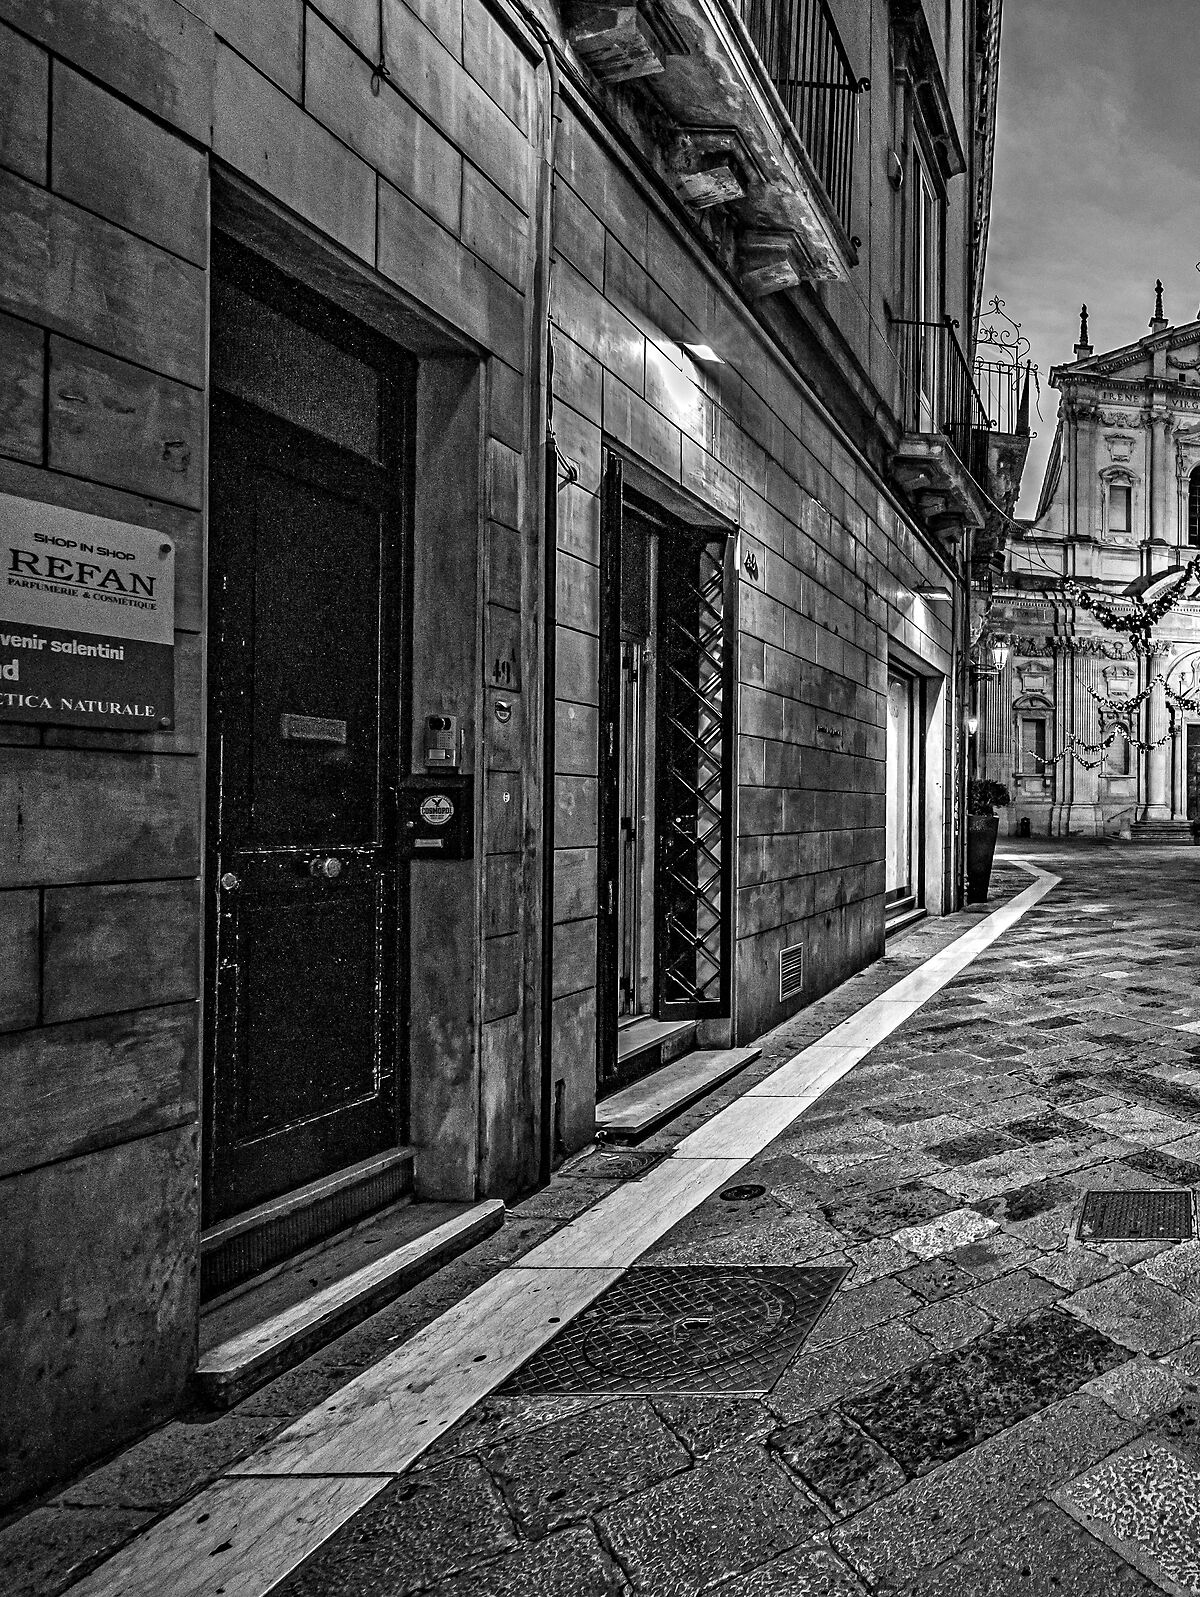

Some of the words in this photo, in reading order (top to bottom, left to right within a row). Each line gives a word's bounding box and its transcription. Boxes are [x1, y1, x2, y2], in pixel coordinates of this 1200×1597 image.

[1103, 391, 1139, 403] IRENE
[34, 533, 77, 549] SHOP
[80, 542, 93, 553] IN
[97, 546, 136, 561] SHOP
[8, 548, 157, 597] REFAN
[8, 577, 78, 597] PARFUMERIE
[83, 590, 91, 599] &
[50, 639, 124, 661] salentini
[60, 698, 156, 717] NATURALE
